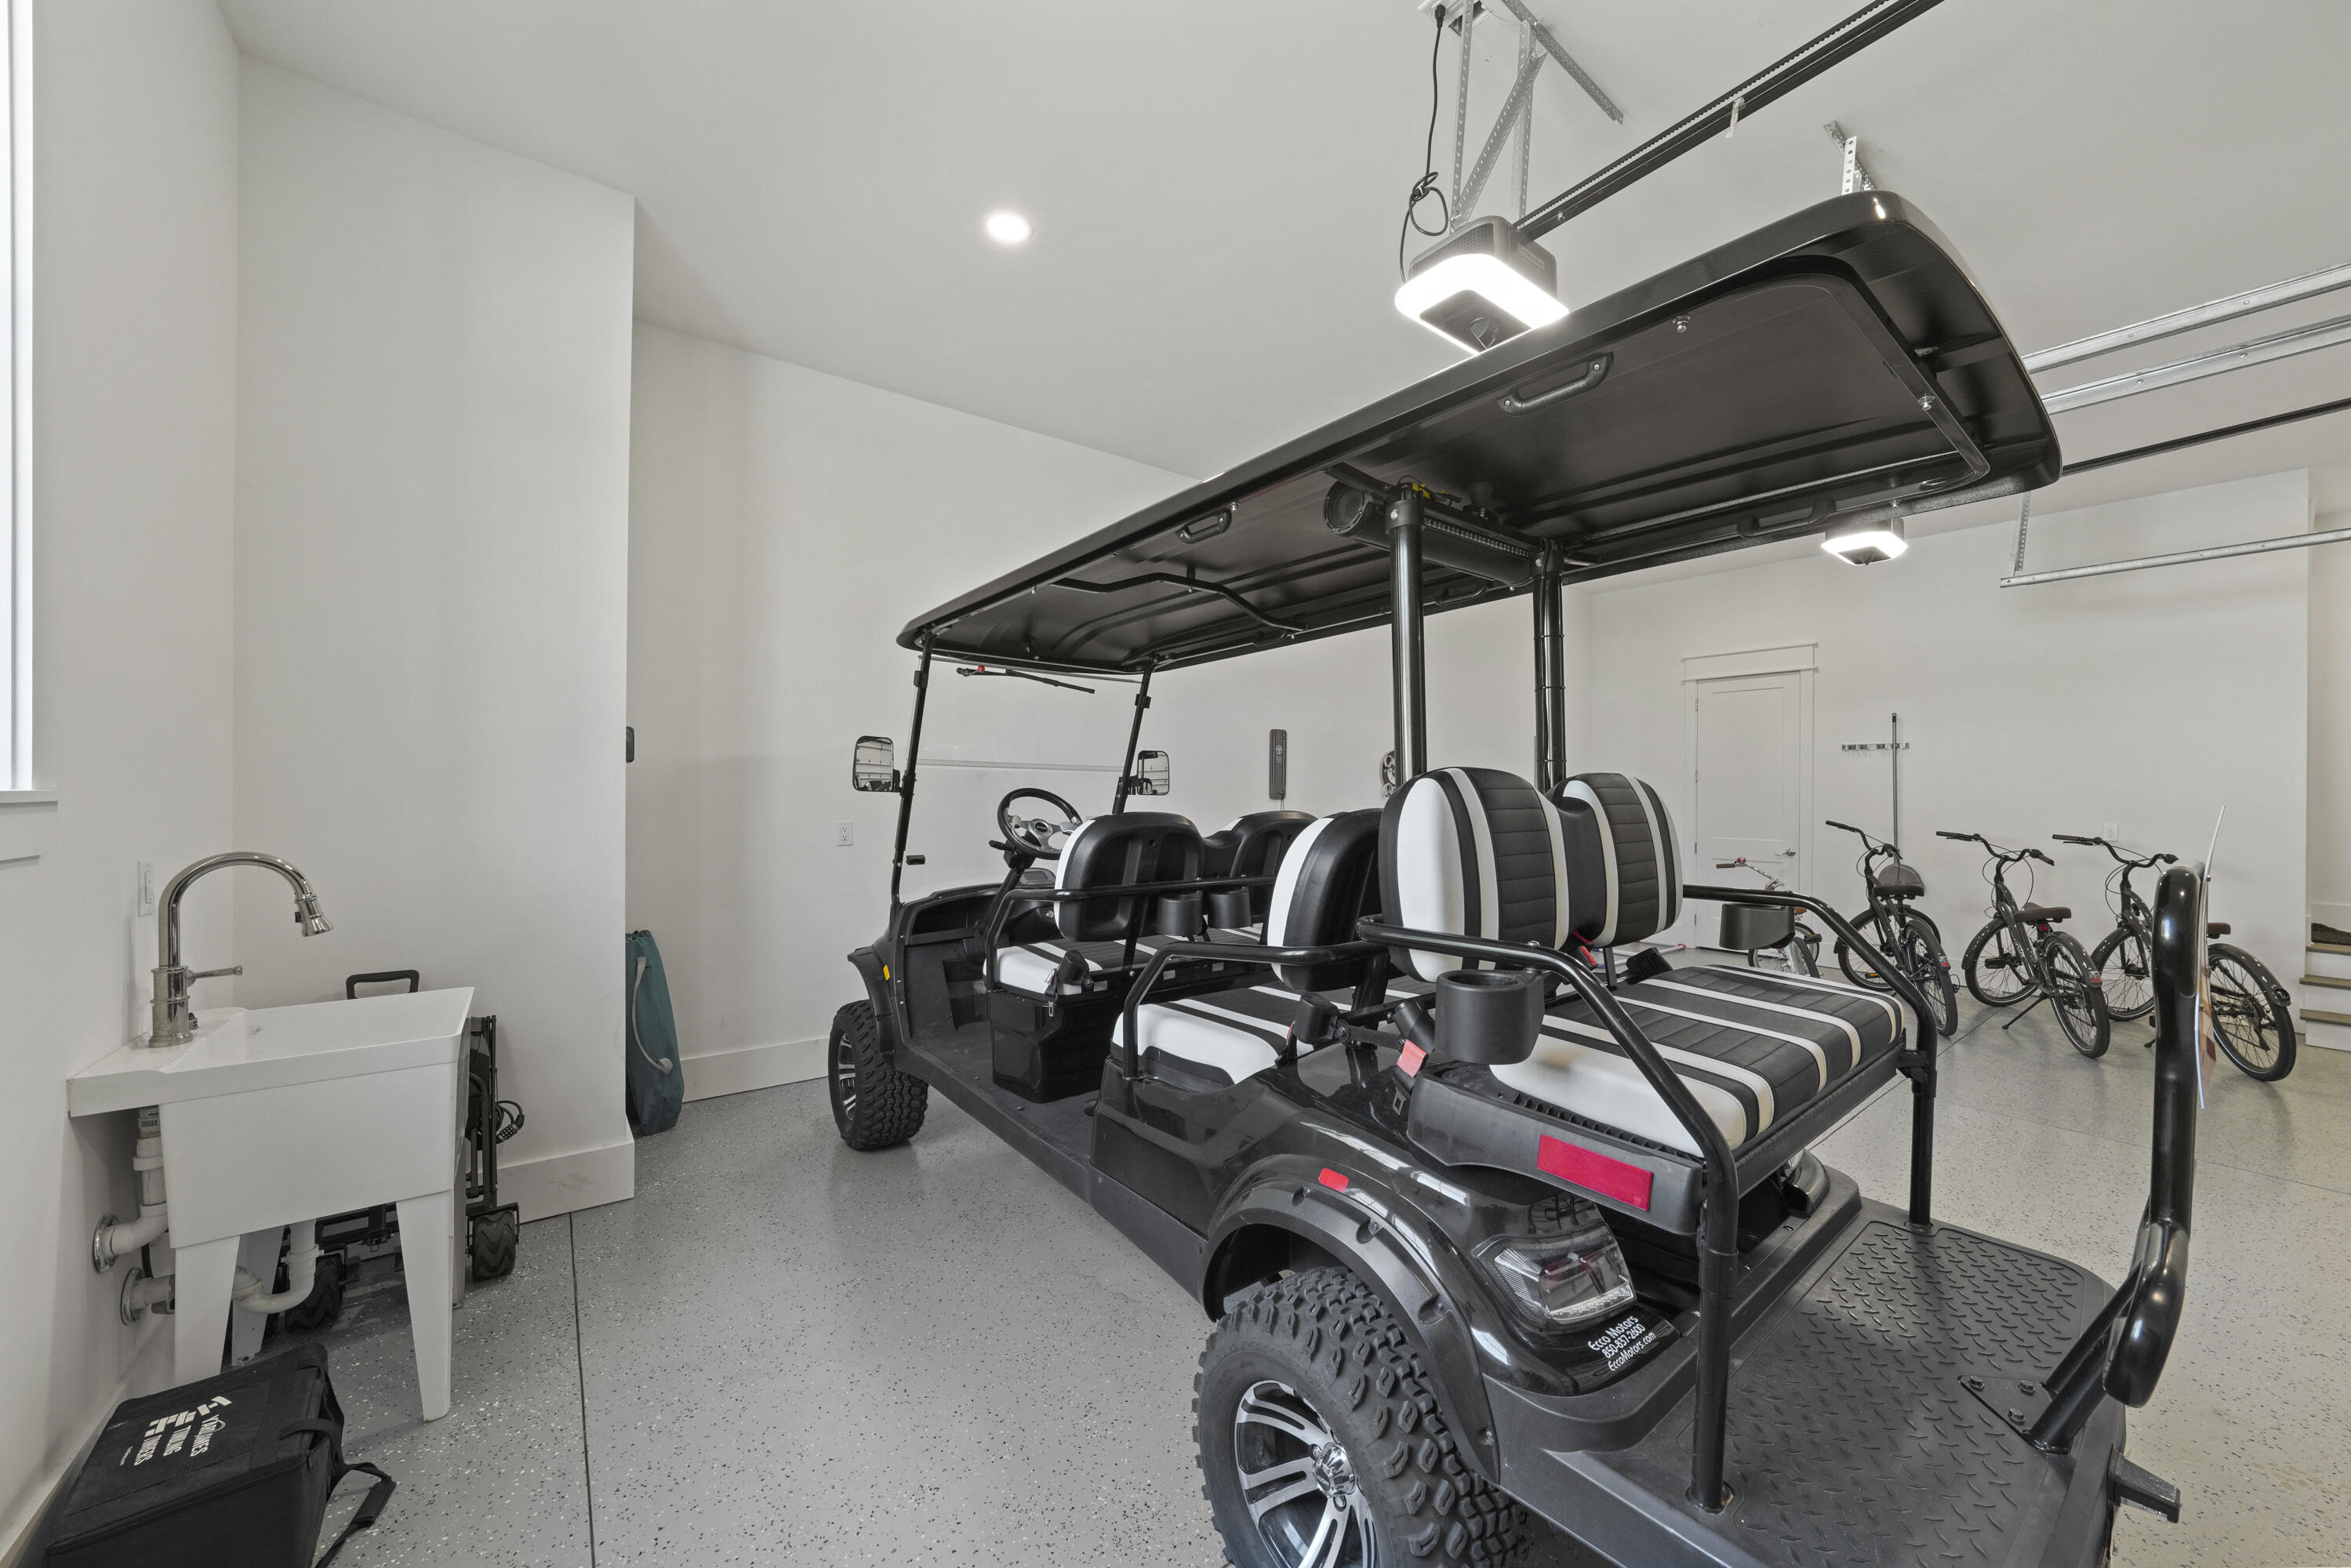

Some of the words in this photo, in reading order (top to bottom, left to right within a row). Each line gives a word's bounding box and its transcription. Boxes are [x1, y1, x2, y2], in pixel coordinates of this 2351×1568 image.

[1588, 1336, 1612, 1351] Ecco
[1605, 1316, 1639, 1339] Motors
[1601, 1323, 1646, 1359] 850-837-2600
[1608, 1331, 1656, 1371] EccoMotors.com
